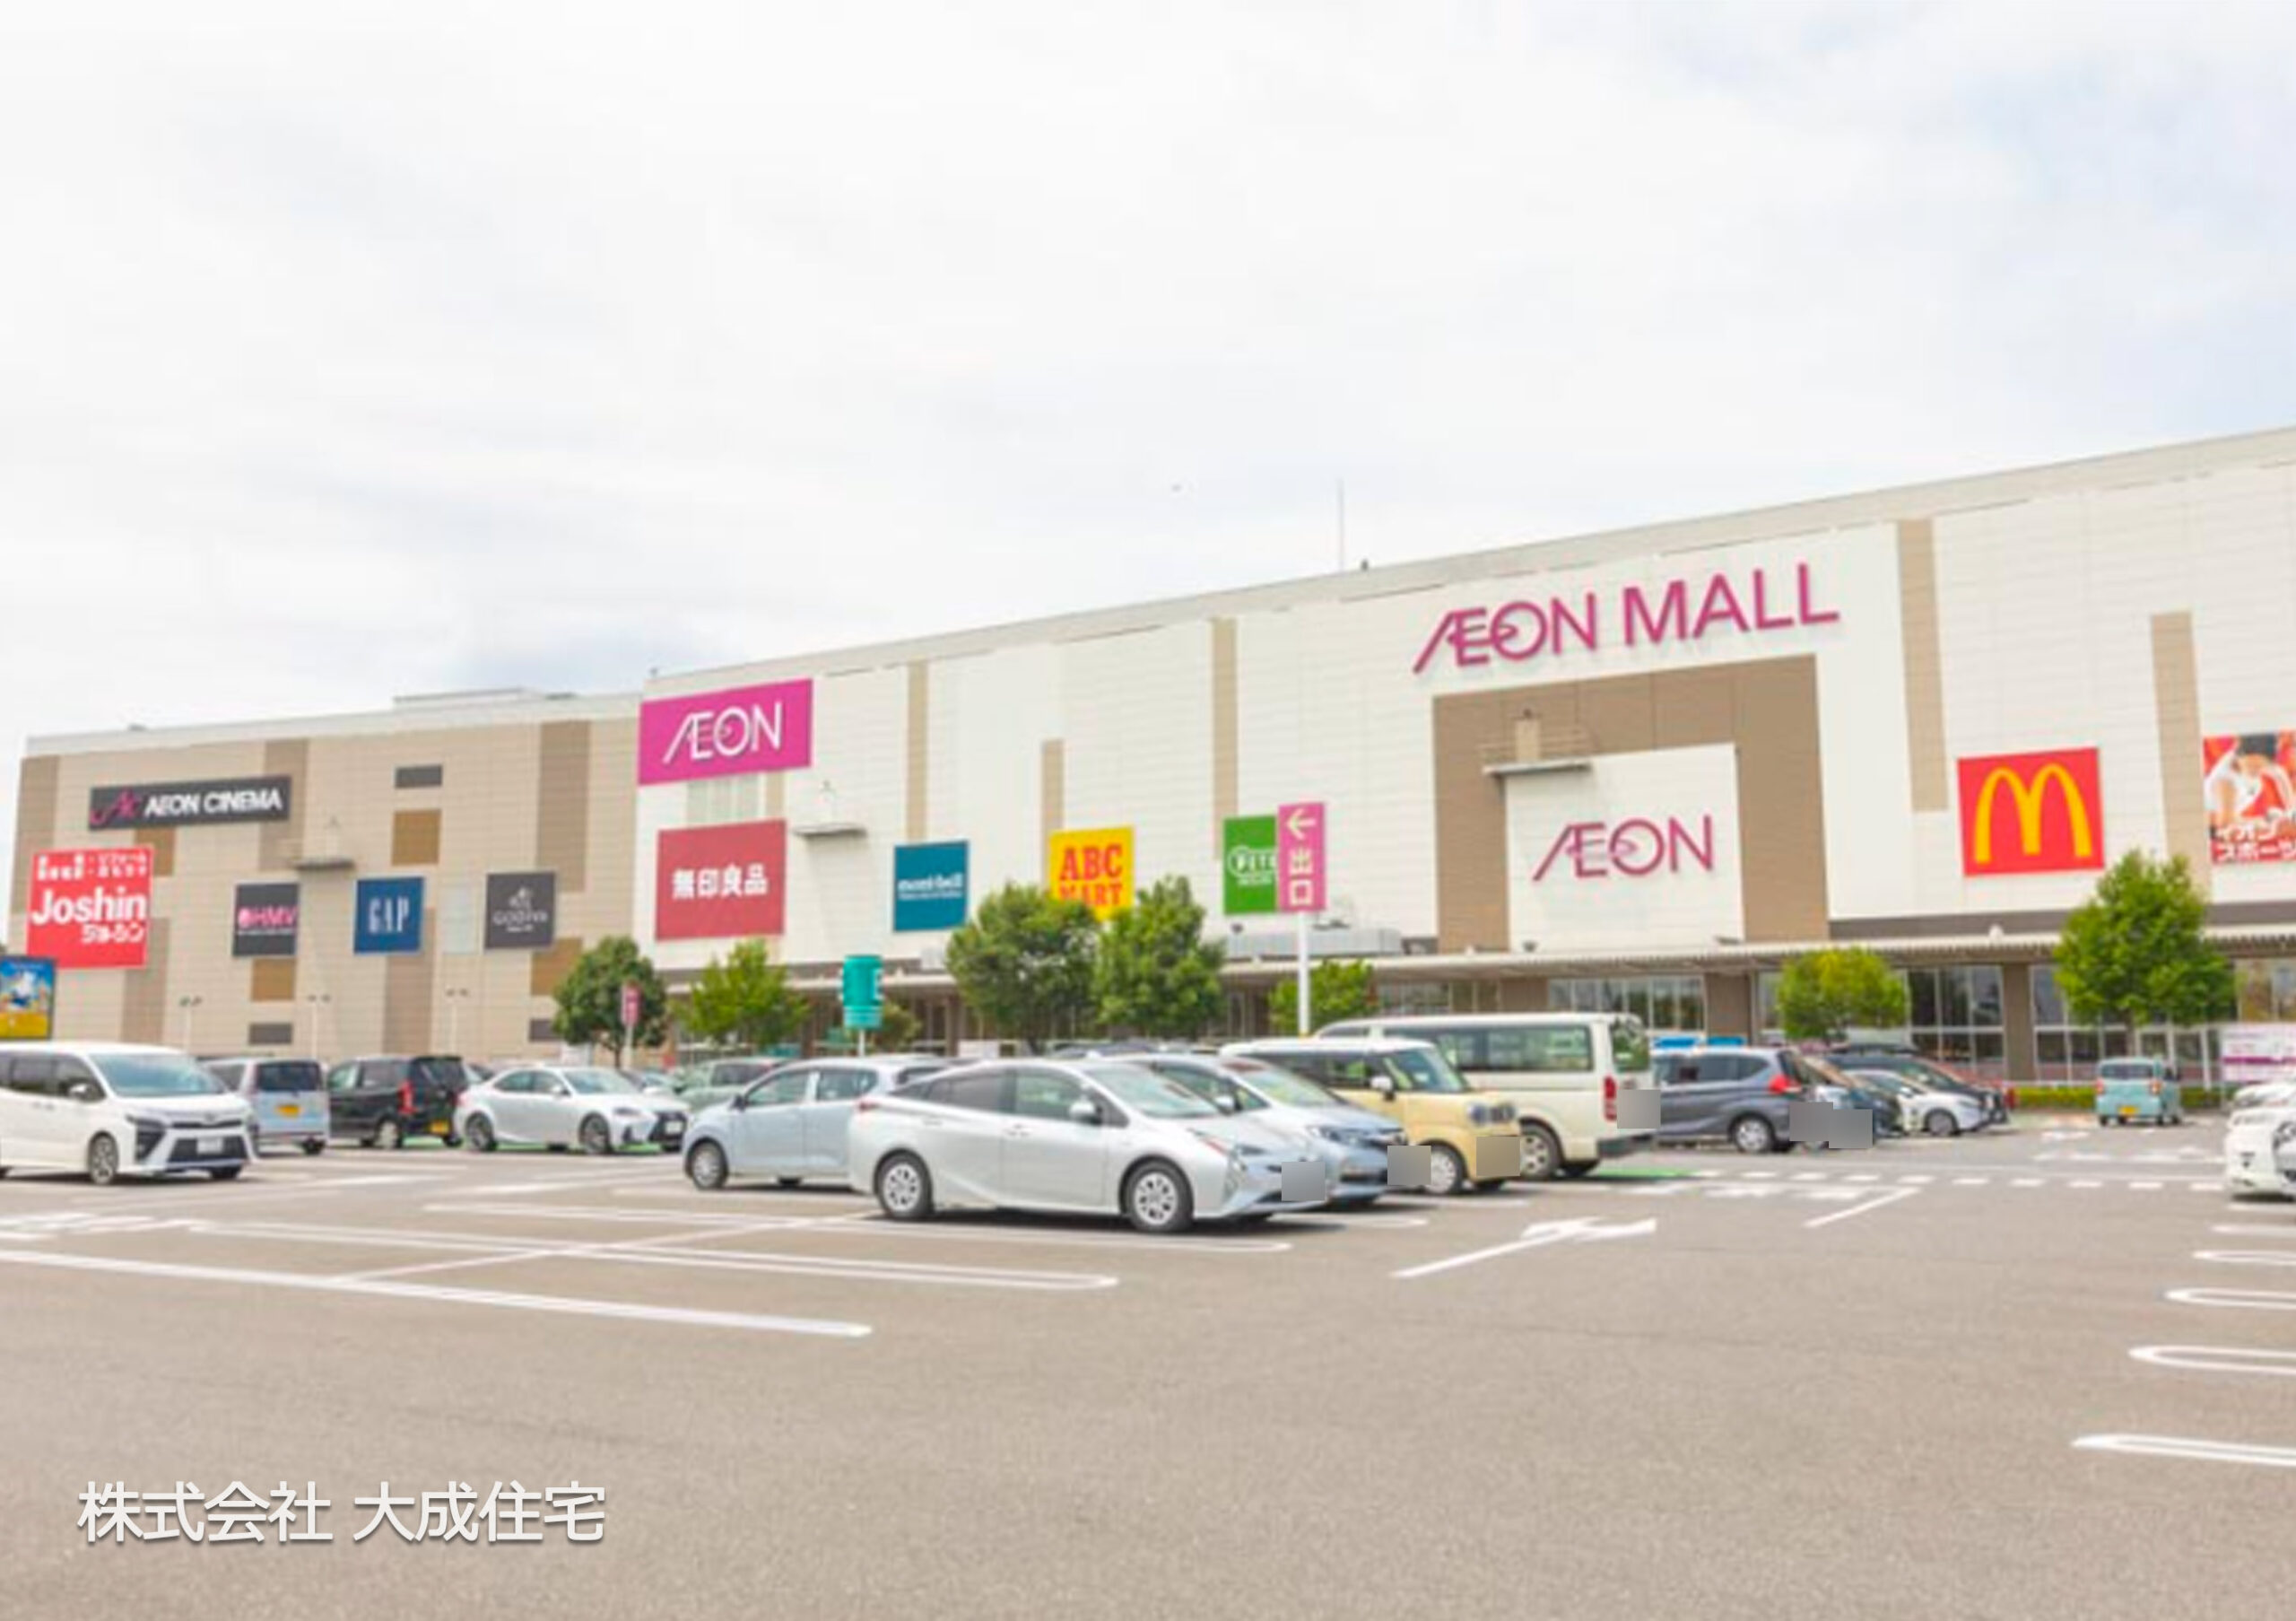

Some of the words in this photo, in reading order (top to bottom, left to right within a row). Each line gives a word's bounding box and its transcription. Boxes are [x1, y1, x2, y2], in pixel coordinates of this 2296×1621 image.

[1622, 563, 1839, 648] MALL
[204, 789, 282, 813] CINEMA
[673, 863, 768, 899] 無印良品
[1059, 843, 1123, 881] ABC
[1289, 848, 1313, 906] 出口
[31, 886, 146, 925] Joshin
[369, 897, 409, 933] GAP
